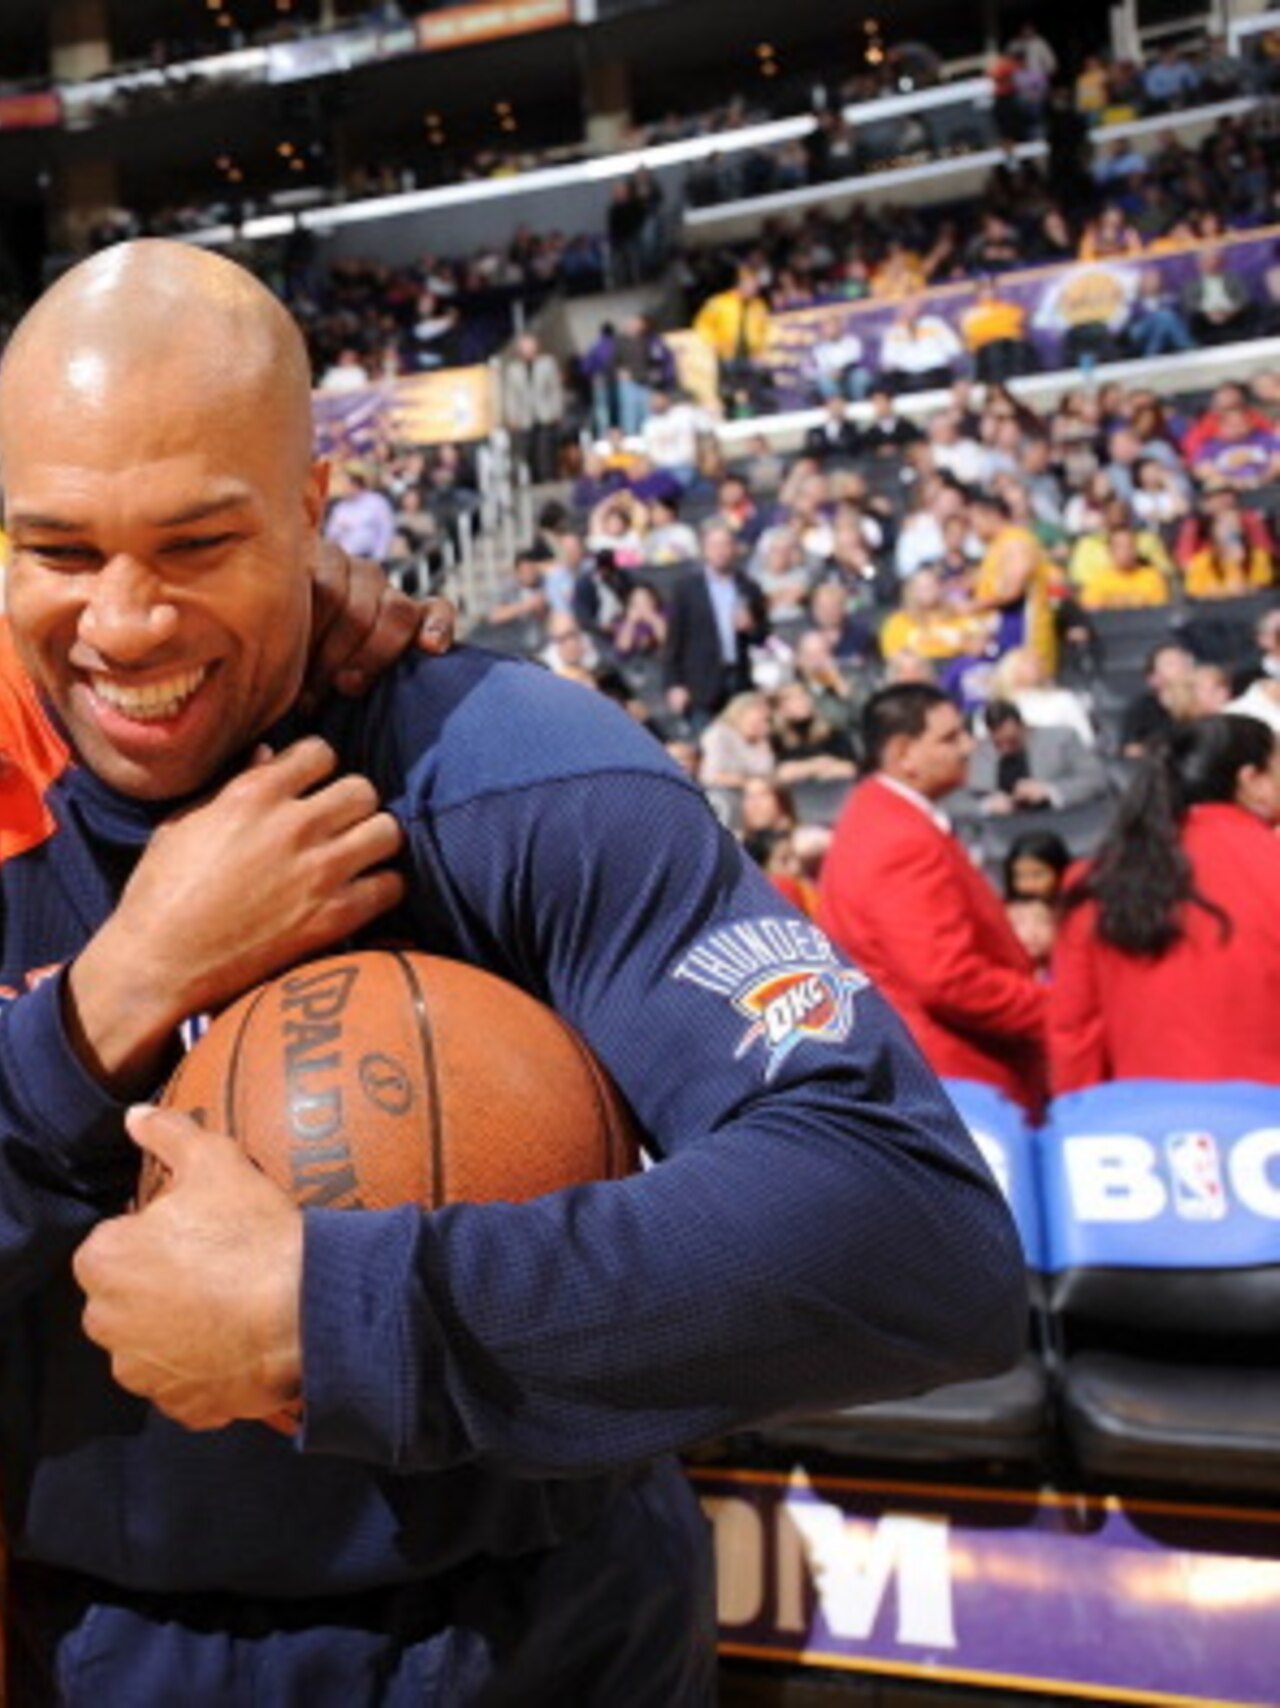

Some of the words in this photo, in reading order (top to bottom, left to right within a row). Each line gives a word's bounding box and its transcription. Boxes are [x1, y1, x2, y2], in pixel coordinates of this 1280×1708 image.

[672, 917, 840, 995] THUNDER
[765, 974, 825, 1044] OKC
[281, 965, 363, 1210] SPALDIN
